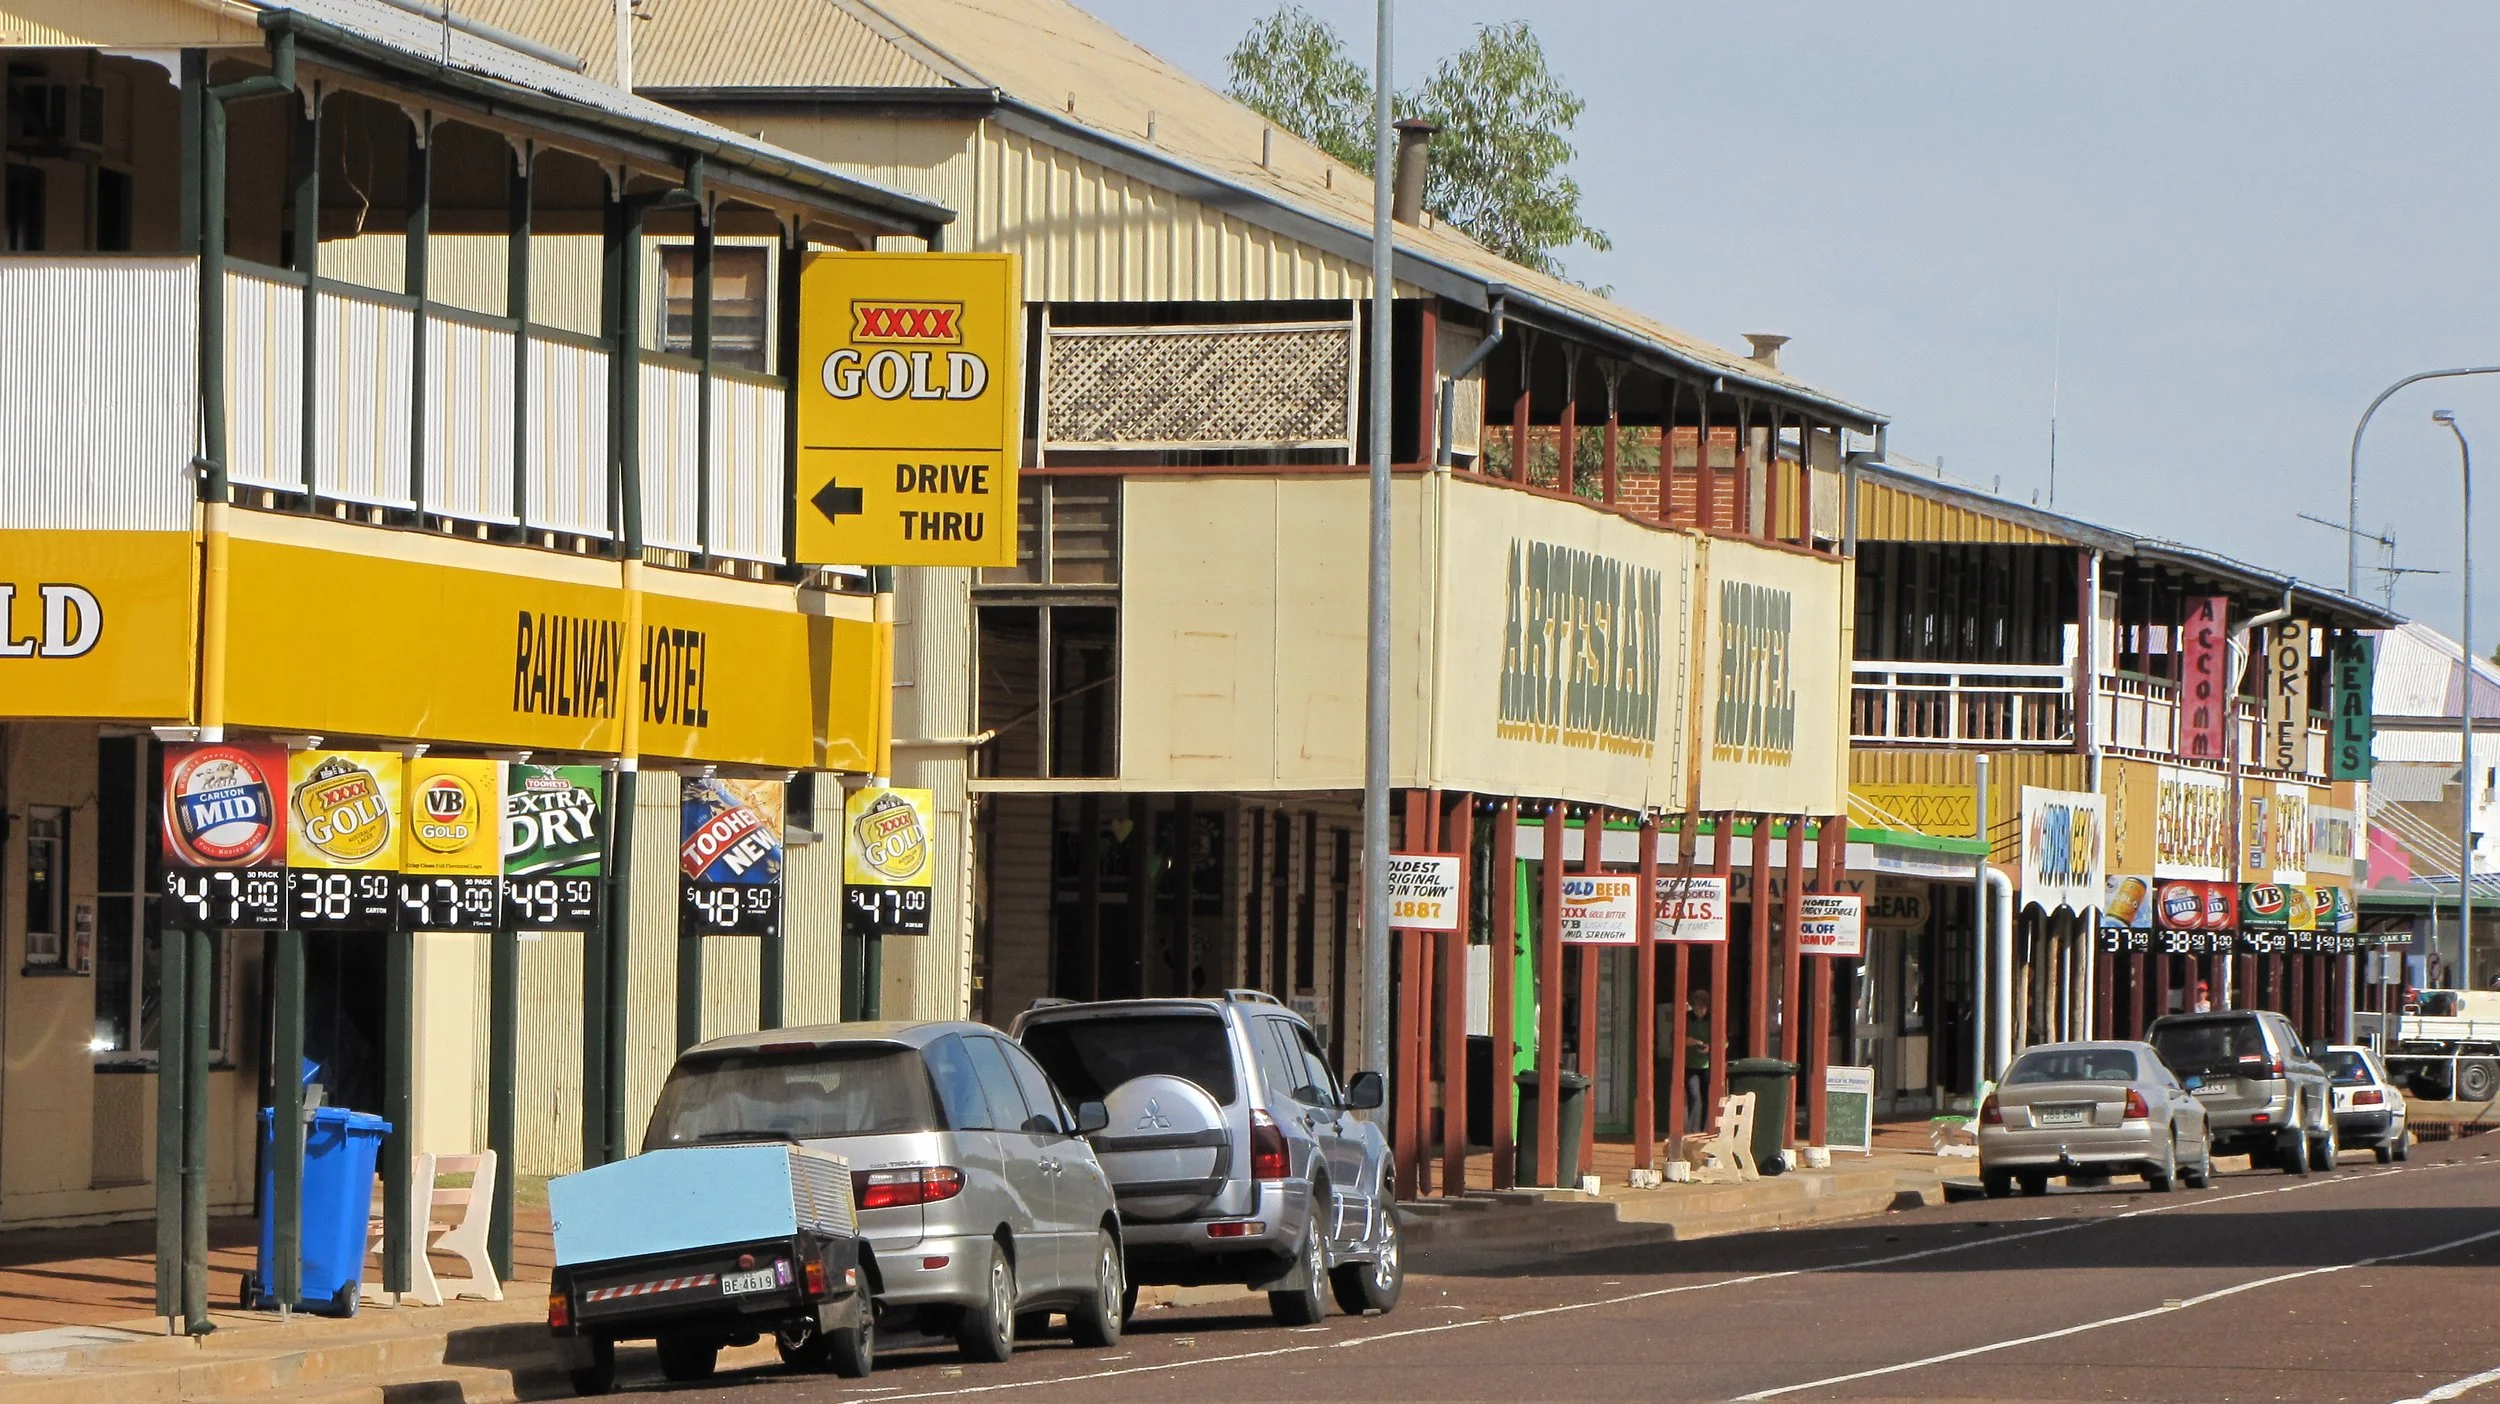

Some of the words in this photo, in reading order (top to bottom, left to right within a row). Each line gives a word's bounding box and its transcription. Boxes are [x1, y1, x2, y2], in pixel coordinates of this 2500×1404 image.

[859, 308, 954, 338] XXXX
[822, 349, 989, 400] GOLD
[896, 464, 989, 494] DRIVE
[900, 511, 984, 541] THRU
[1497, 536, 1662, 760] ARTESIAN
[1712, 579, 1795, 767] HOTEL
[514, 610, 627, 719] RAILWAY
[640, 625, 709, 728] HOTEL
[2277, 620, 2300, 771] POKIES
[2340, 641, 2365, 771] MEALS
[200, 787, 245, 802] CARLTON
[325, 782, 367, 806] XXXX
[528, 780, 568, 788] TOOHEYS
[194, 796, 257, 830] MID
[428, 790, 463, 813] VB
[506, 788, 593, 815] EXTRA
[306, 794, 387, 844] GOLD
[505, 803, 596, 856] DRY
[880, 814, 910, 833] XXXX
[422, 825, 468, 839] GOLD
[722, 828, 777, 876] NEW
[866, 825, 924, 865] GOLD
[1396, 885, 1410, 896] IN
[1562, 882, 1594, 896] OLD
[1596, 883, 1631, 896] BEER
[2252, 888, 2281, 907] VB
[398, 879, 492, 925] 47.00
[1393, 901, 1441, 918] 1887
[2171, 901, 2196, 914] MID
[2208, 903, 2224, 912] ID
[1585, 931, 1626, 939] STRENGTH
[1816, 924, 1835, 934] OFF
[1822, 935, 1836, 946] UP
[2380, 934, 2399, 943] OAK
[2401, 934, 2413, 942] ST
